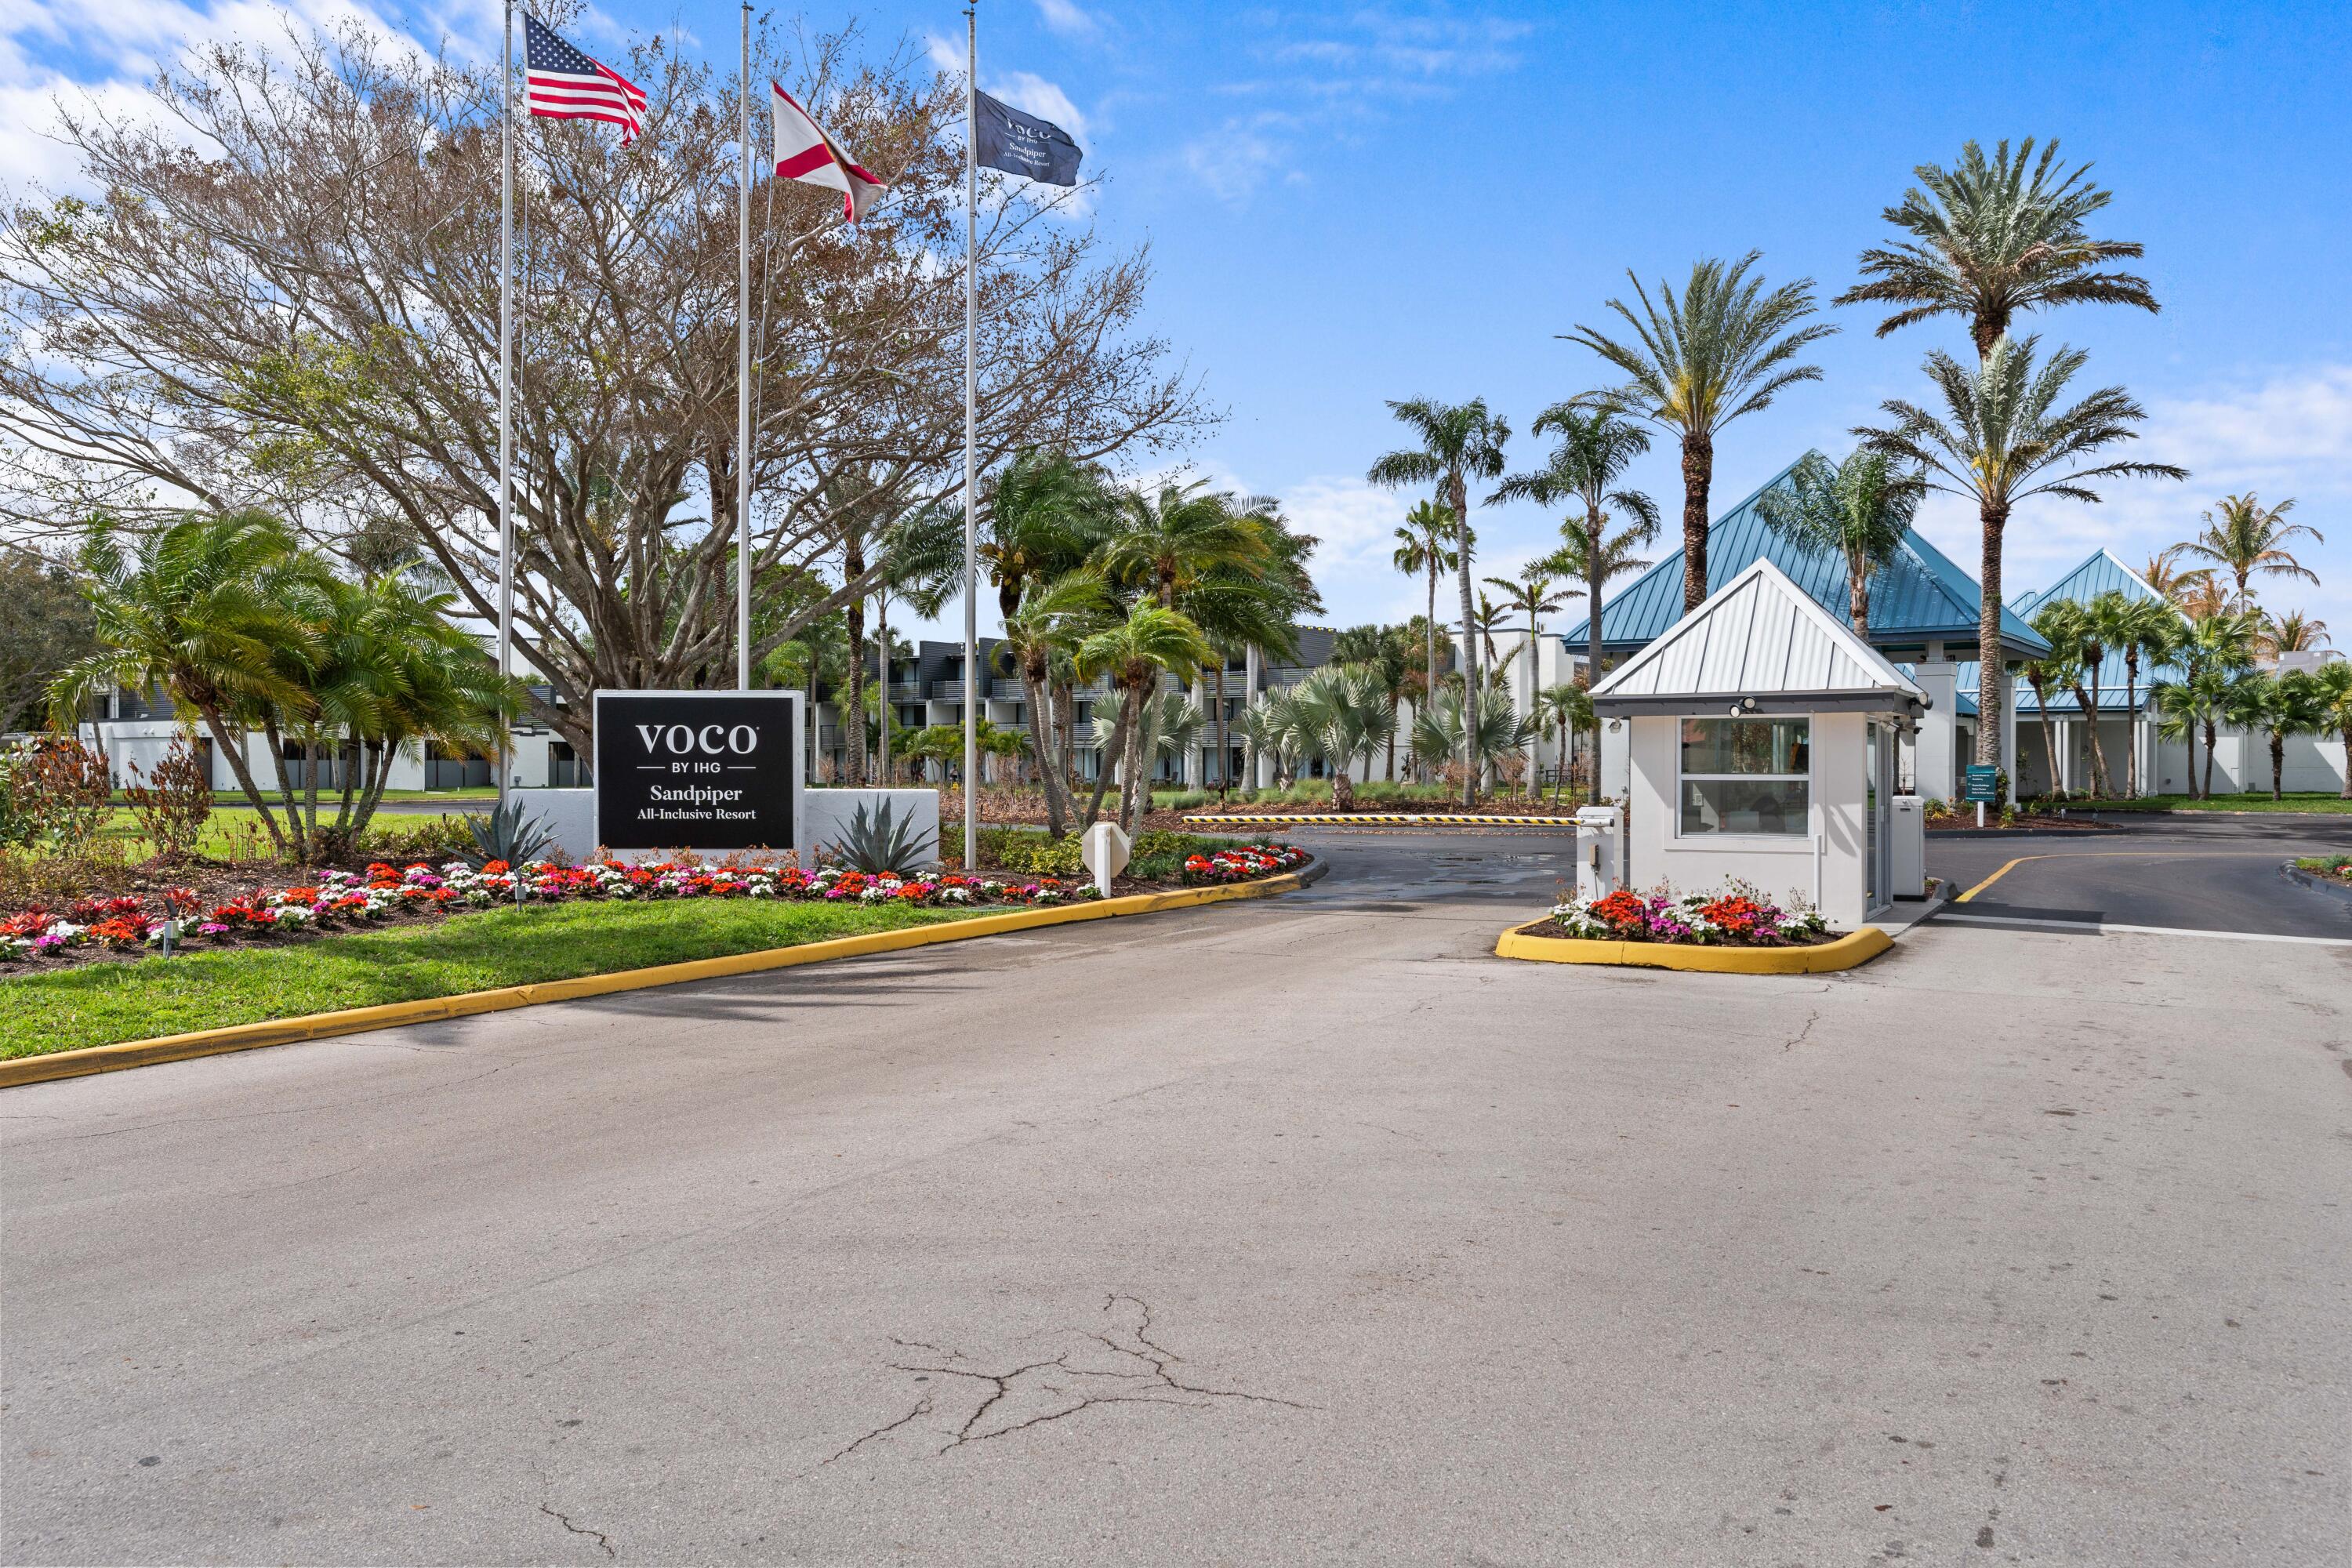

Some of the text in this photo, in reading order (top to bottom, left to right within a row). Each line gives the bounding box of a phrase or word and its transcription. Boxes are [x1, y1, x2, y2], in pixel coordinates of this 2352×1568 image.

[1009, 142, 1047, 158] Sandpiper
[635, 724, 758, 754] VOCO
[672, 762, 721, 773] BY IHG
[650, 785, 743, 806] Sandpiper
[637, 808, 757, 819] All-Inclusive Resort
